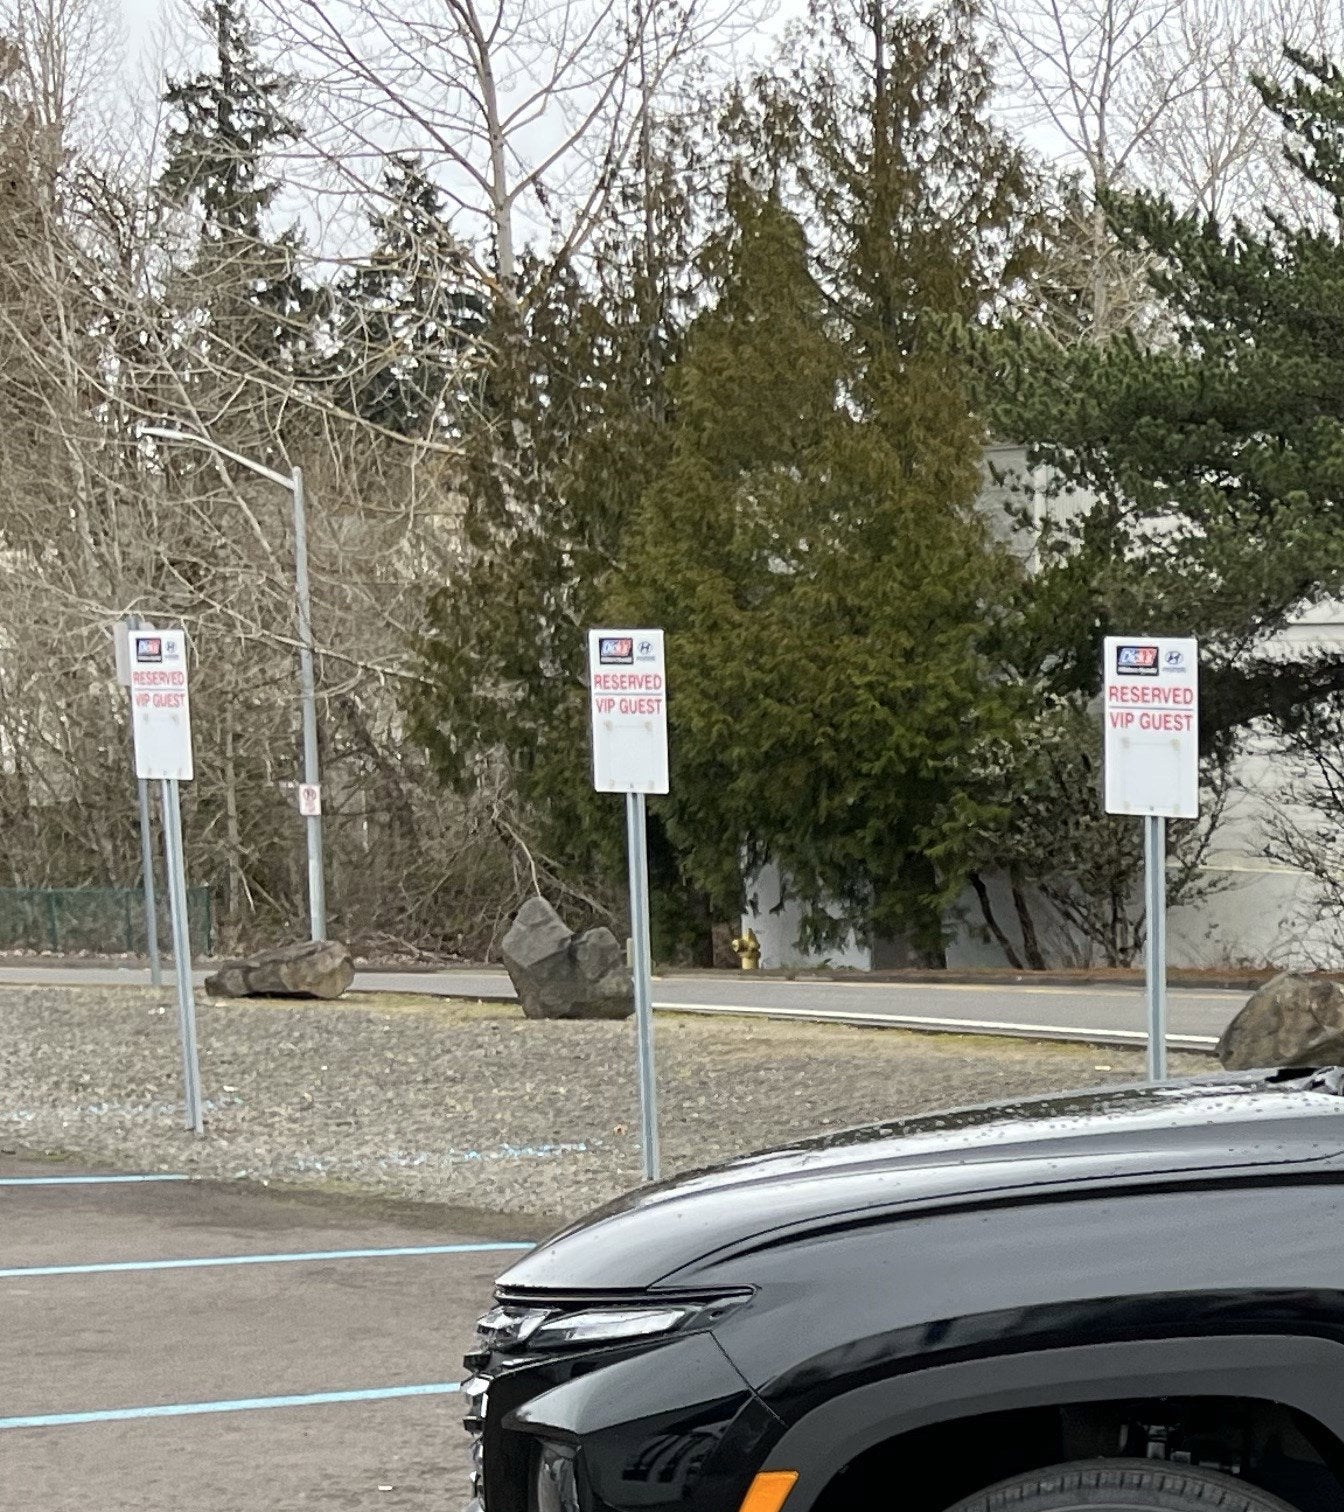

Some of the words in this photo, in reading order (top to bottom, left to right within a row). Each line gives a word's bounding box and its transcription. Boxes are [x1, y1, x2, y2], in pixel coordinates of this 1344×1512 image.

[133, 671, 184, 686] RESERVED
[594, 673, 662, 690] RESERVED
[153, 693, 185, 708] GUEST
[1109, 685, 1194, 704] RESERVED
[596, 698, 615, 714] VIP
[620, 698, 662, 714] GUEST
[1110, 712, 1134, 728] VIP
[1140, 712, 1192, 731] GUEST
